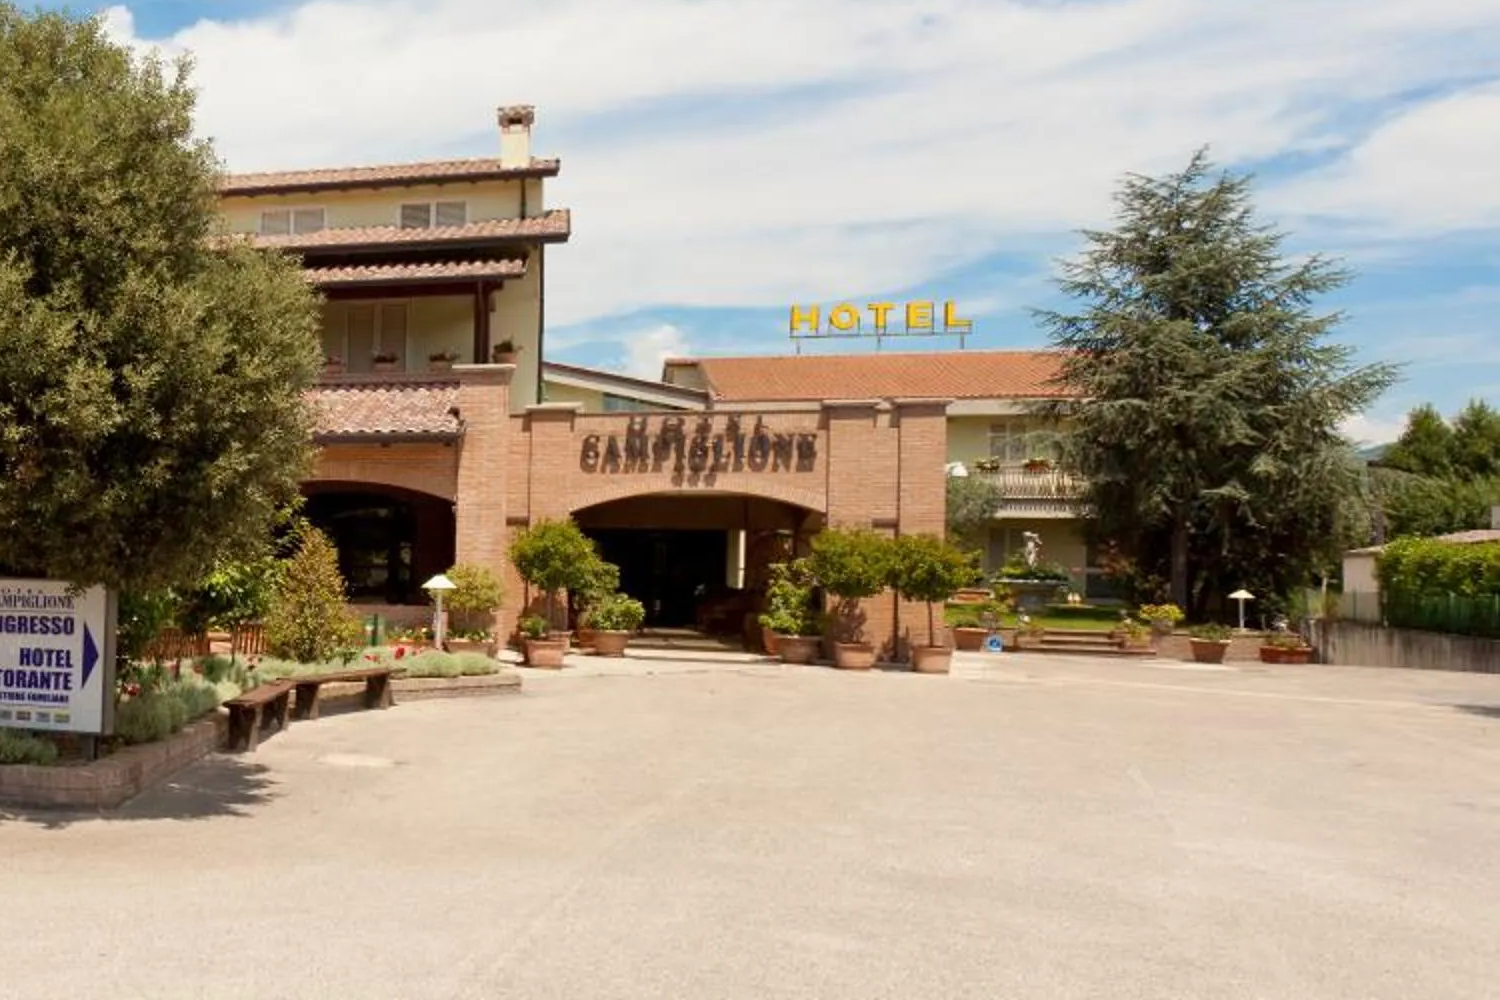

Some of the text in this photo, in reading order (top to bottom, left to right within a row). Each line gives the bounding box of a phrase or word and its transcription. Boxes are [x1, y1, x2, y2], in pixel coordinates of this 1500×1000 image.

[790, 302, 973, 331] HOTEL
[580, 433, 818, 473] CAMPIGLIONE
[19, 647, 74, 668] HOTEL
